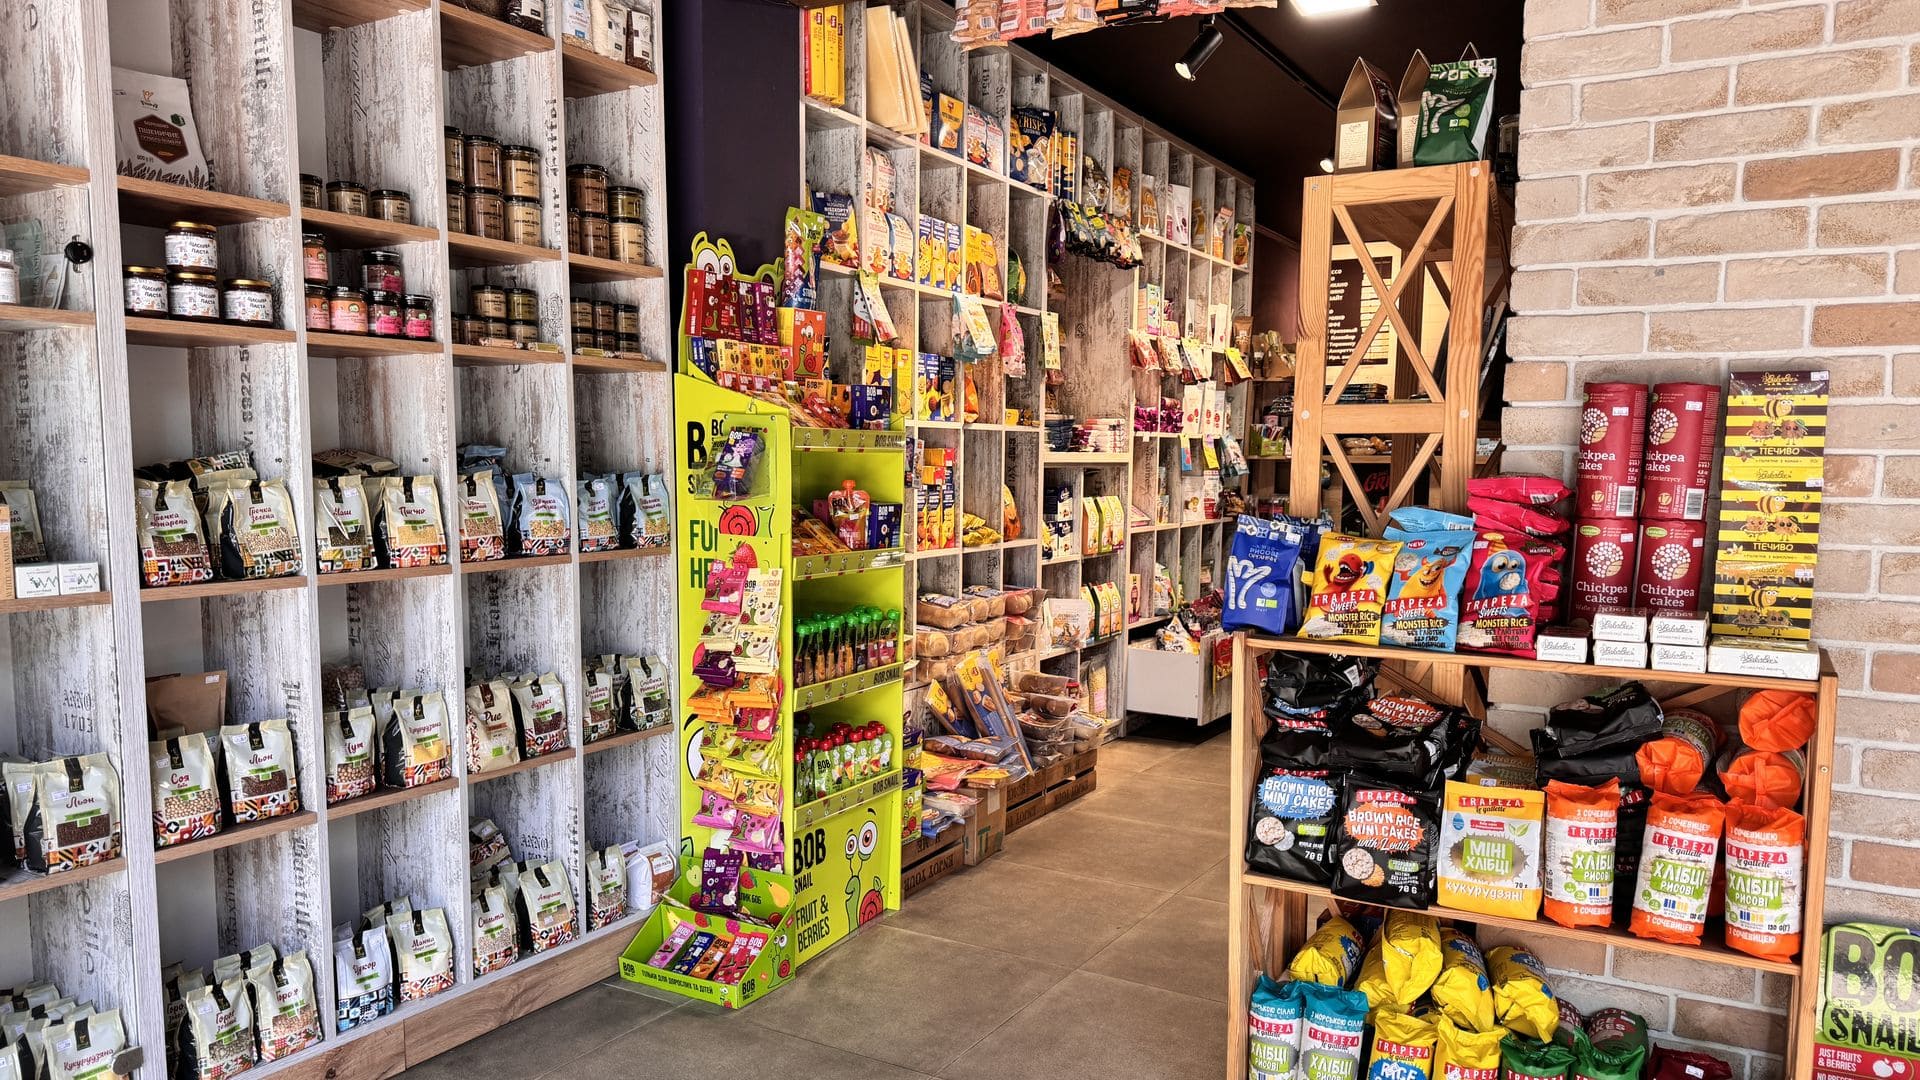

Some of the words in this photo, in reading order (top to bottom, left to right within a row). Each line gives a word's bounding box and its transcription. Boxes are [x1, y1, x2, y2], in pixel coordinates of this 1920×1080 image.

[1760, 447, 1800, 456] ПЕЧИВО
[1407, 540, 1425, 549] NEW
[1753, 542, 1794, 552] ПЕЧИВО
[1576, 581, 1628, 594] Chickpea
[1640, 583, 1695, 597] Chickpea
[1313, 591, 1376, 605] TRAPEZA
[1385, 596, 1444, 612] TRAPEZA
[1466, 595, 1529, 612] TRAPEZA
[1585, 593, 1619, 604] cakes
[1650, 596, 1685, 607] cakes
[1329, 601, 1358, 613] SWEETS
[1328, 612, 1359, 622] MONSTER
[1359, 612, 1375, 621] RICE
[1396, 619, 1429, 630] MONSTER
[1429, 619, 1444, 627] RICE
[1475, 618, 1509, 629] MONSTER
[1510, 618, 1529, 627] RICE
[1370, 702, 1396, 716] MINI
[1398, 711, 1437, 723] CAKES
[1416, 708, 1443, 718] RICE
[817, 758, 831, 770] BOB
[171, 773, 190, 785] Соя
[1265, 779, 1304, 794] BROWN
[1307, 785, 1334, 797] RICE
[1264, 791, 1290, 805] MINI
[1293, 795, 1333, 810] CAKES
[1359, 791, 1415, 803] TRAPEZA
[1461, 797, 1521, 807] TRAPEZA
[1348, 810, 1393, 824] BROWN
[1395, 815, 1421, 830] RICE
[1351, 824, 1379, 836] MINI
[1382, 825, 1418, 840] CAKES
[1571, 827, 1616, 838] TRAPEZ
[1734, 828, 1778, 841] СОЧЕВИЦЕЮ
[794, 828, 826, 874] BOB
[1357, 838, 1378, 848] with
[1380, 838, 1411, 851] Lentils
[1469, 840, 1506, 859] МІНІ
[1654, 834, 1713, 854] TRAPEZA
[1727, 844, 1785, 863] TRAPEZA
[704, 859, 716, 868] BOB
[1465, 856, 1510, 875] ХЛІБЦІ
[1653, 861, 1705, 889] ХЛІБЦІ
[794, 872, 813, 895] SNAIL
[1661, 881, 1694, 896] РИСОВІ
[1729, 873, 1779, 900] ХЛІБЦІ
[1735, 893, 1768, 908] РИСОВІ
[795, 901, 818, 929] FRUIT
[820, 894, 829, 914] &
[749, 936, 763, 948] BOB
[798, 917, 830, 953] BERRIES
[1733, 928, 1776, 944] СОЧЕВИЦЕЮ
[622, 962, 635, 974] BOB
[1832, 930, 1920, 1013] BO
[693, 983, 700, 991] ТА
[742, 978, 756, 995] BOB
[1310, 1028, 1359, 1046] TRAPEZA
[1829, 1007, 1920, 1053] SNAIL
[1251, 1039, 1288, 1064] ХЛІБЦІ
[1377, 1040, 1429, 1058] TRAPEZA
[1818, 1047, 1836, 1058] JUST
[1836, 1050, 1863, 1064] FRUITS
[63, 1048, 114, 1072] Кукурудзяна
[1310, 1054, 1353, 1076] ХЛІБЦІ
[1818, 1057, 1825, 1067] &
[1826, 1058, 1857, 1072] BERRIES
